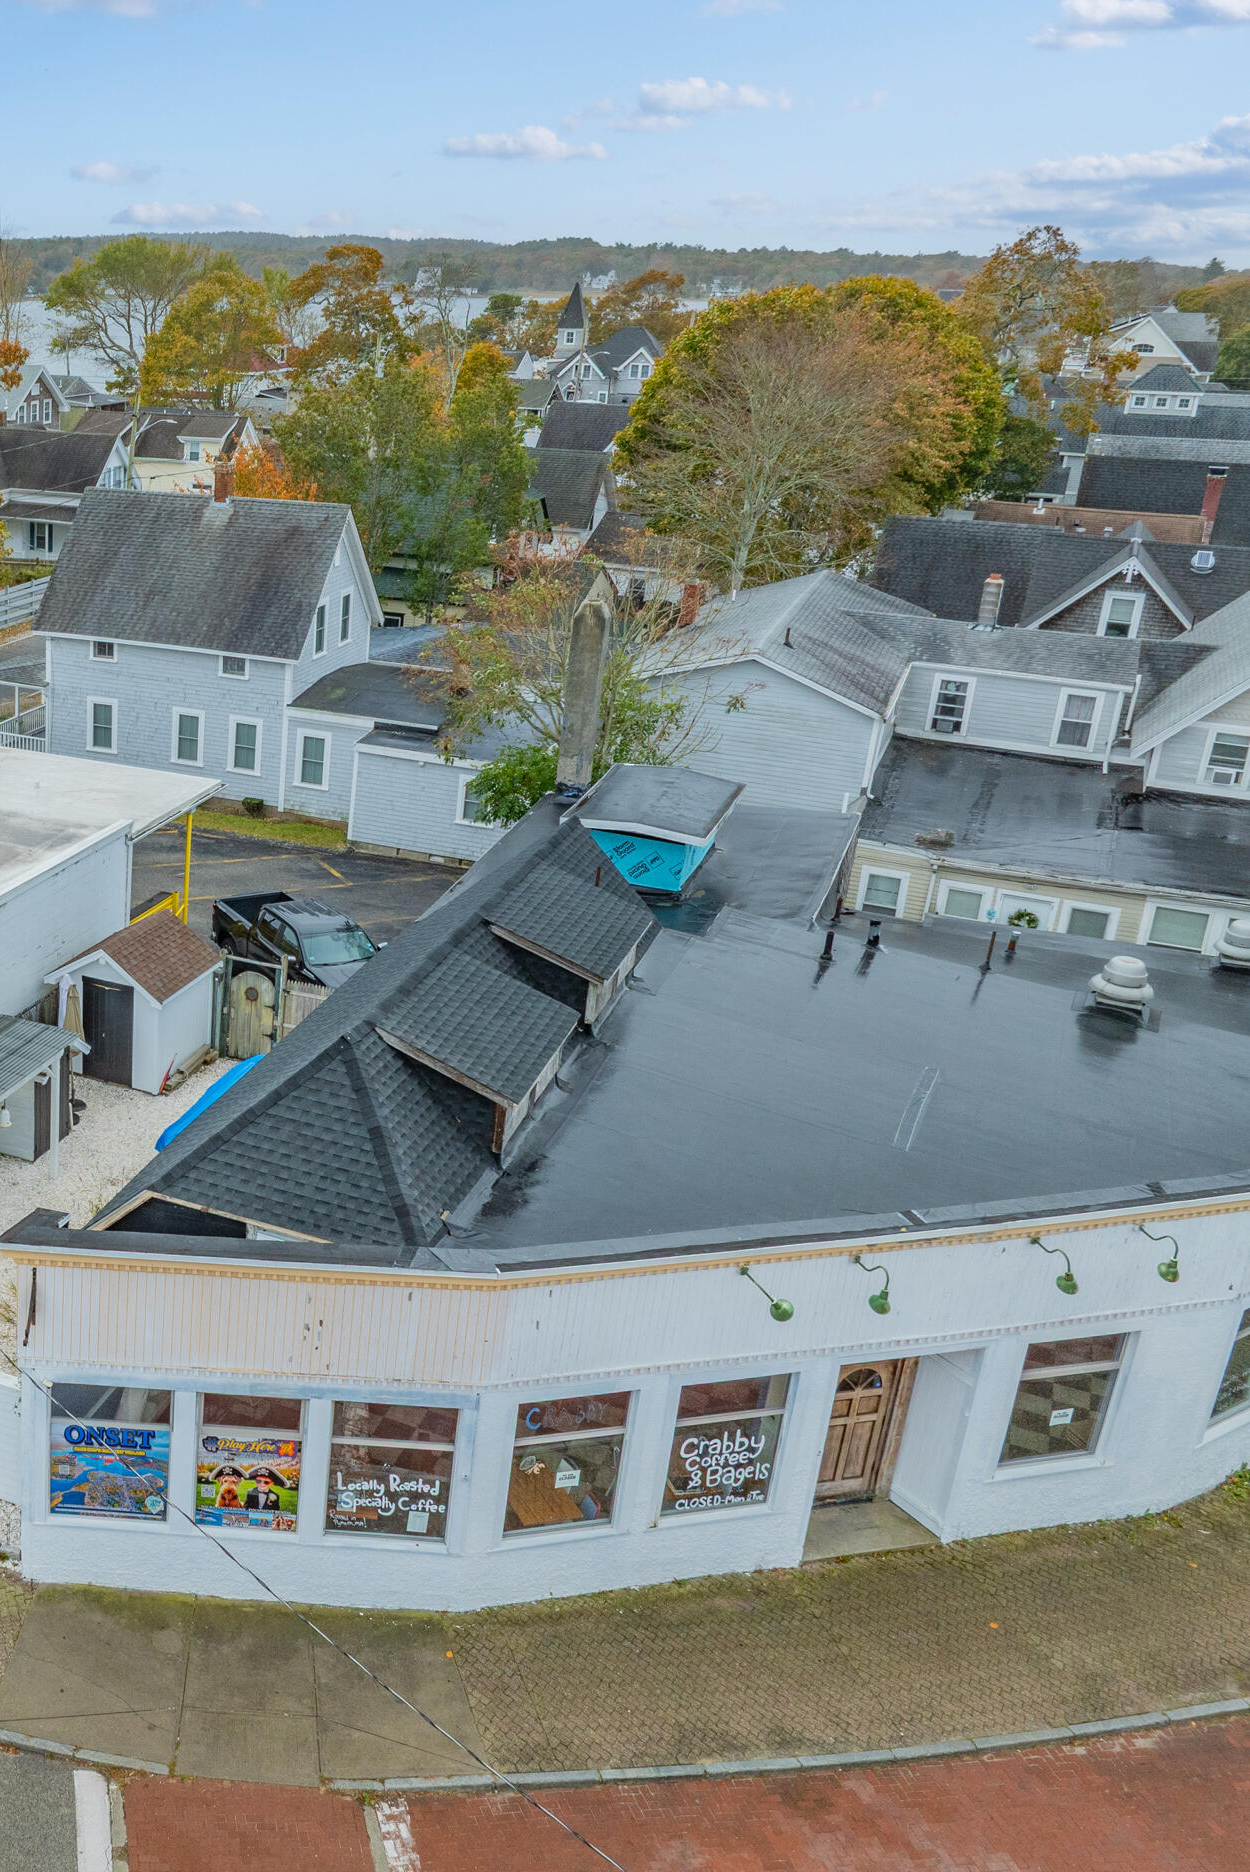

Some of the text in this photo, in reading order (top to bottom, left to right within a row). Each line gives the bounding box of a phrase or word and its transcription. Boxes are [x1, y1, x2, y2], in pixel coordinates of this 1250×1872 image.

[64, 1425, 156, 1450] ONSET
[679, 1428, 766, 1459] Crabby
[685, 1451, 749, 1472] Coffee
[336, 1471, 440, 1497] Locally Roasted
[706, 1462, 771, 1487] Bagels
[341, 1491, 446, 1516] Specialty Coffee
